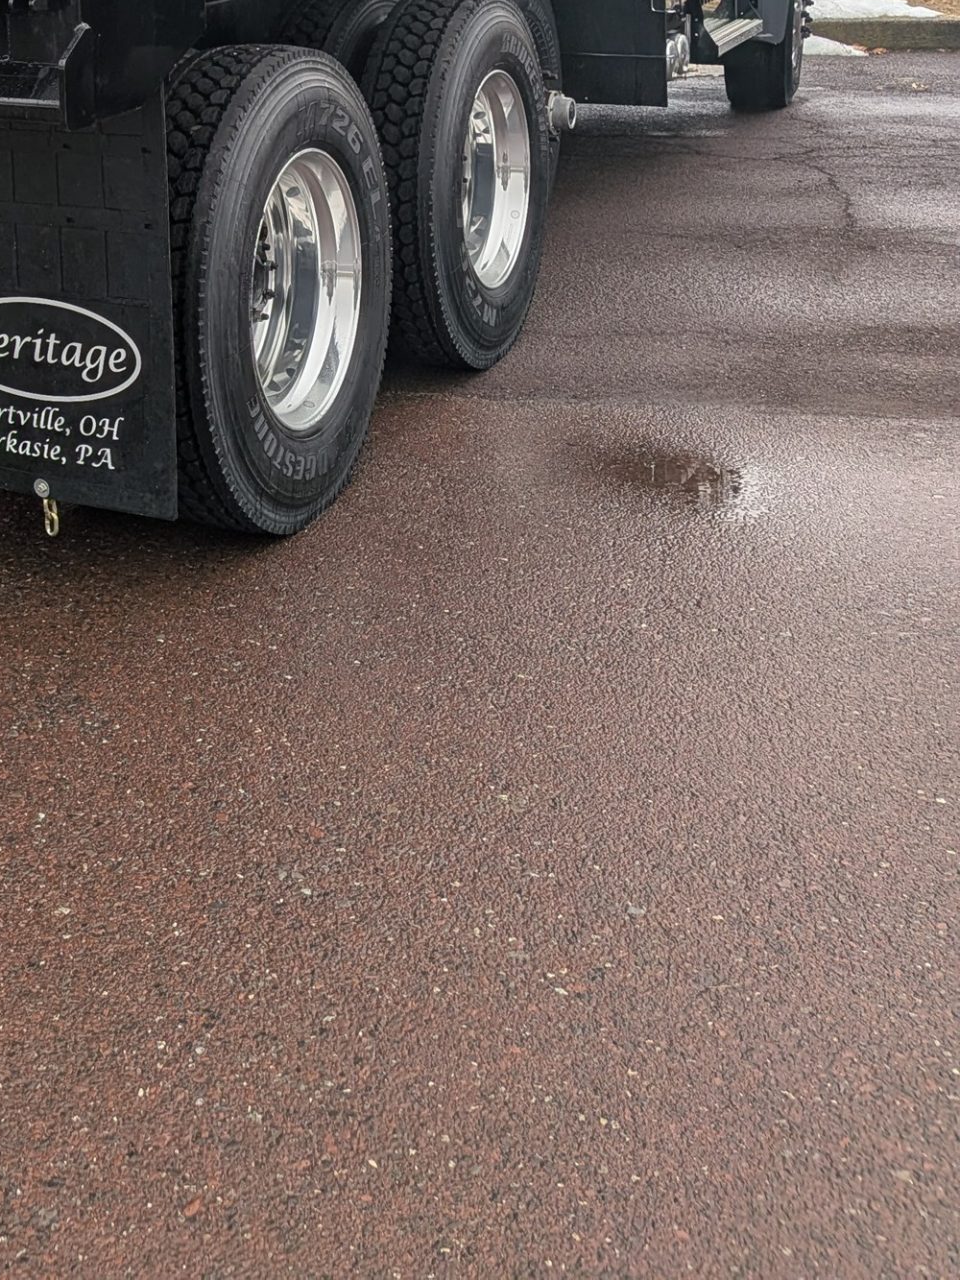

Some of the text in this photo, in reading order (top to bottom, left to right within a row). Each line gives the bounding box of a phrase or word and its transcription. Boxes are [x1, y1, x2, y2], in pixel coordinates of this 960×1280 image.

[79, 414, 125, 441] OH
[246, 394, 334, 481] DGESTONE
[75, 443, 116, 470] PA
